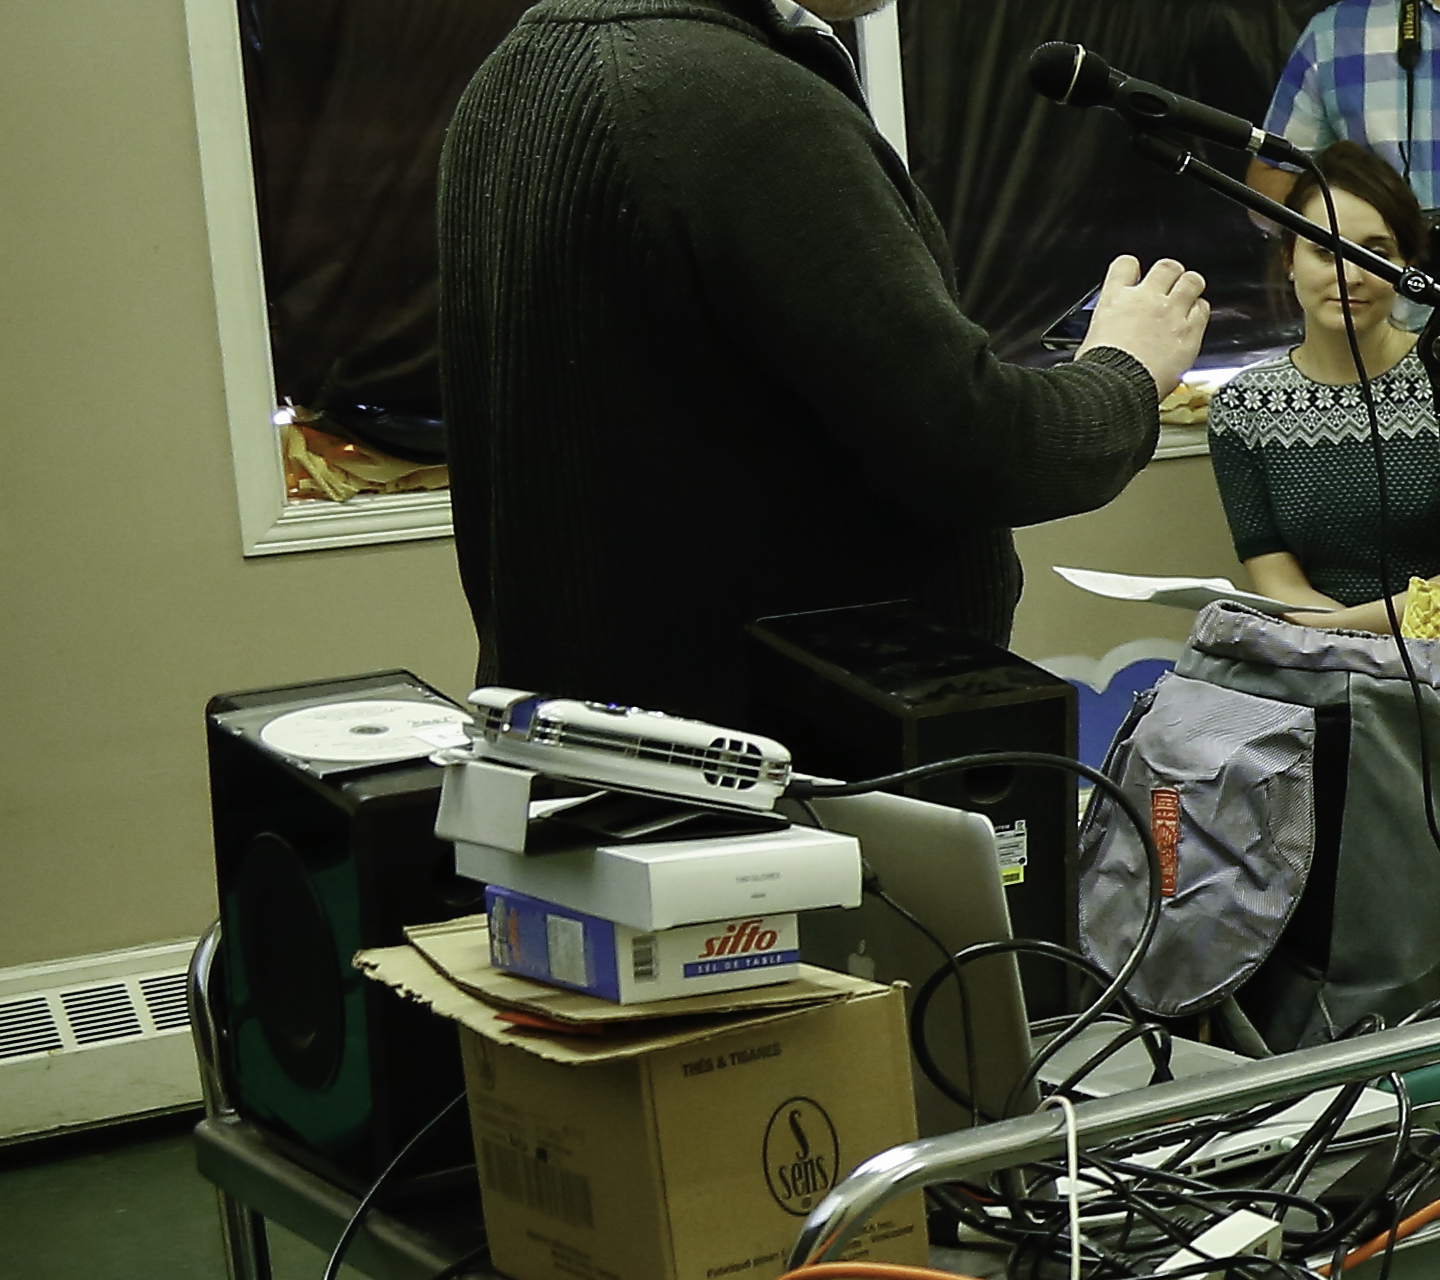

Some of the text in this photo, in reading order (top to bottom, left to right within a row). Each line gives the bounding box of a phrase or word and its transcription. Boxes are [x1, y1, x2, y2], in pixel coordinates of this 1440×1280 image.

[1403, 3, 1415, 40] Nikon
[698, 919, 778, 959] sifto
[725, 960, 739, 970] DE
[746, 955, 781, 967] TABLE
[777, 1155, 829, 1200] sens
